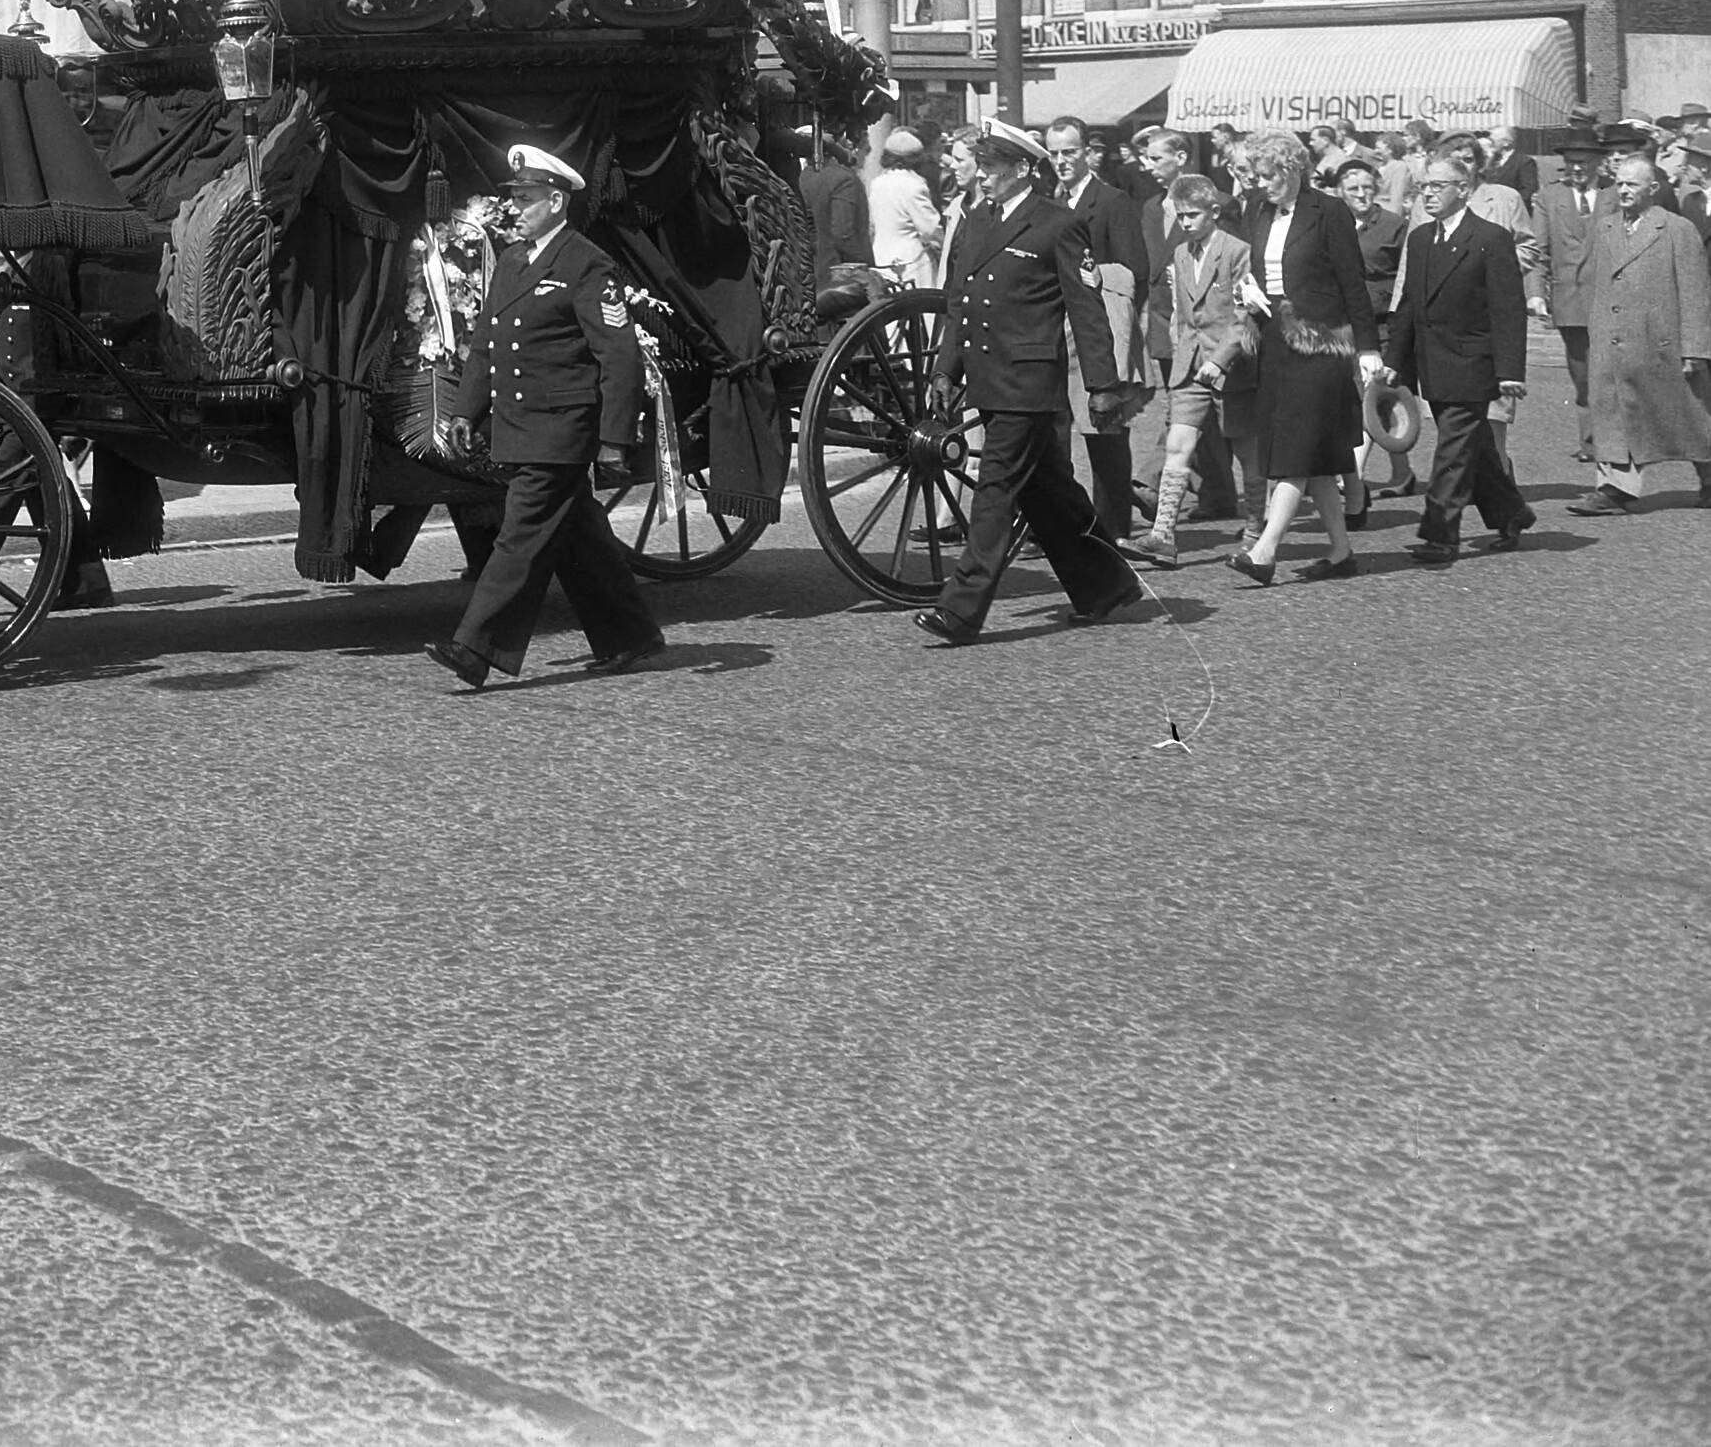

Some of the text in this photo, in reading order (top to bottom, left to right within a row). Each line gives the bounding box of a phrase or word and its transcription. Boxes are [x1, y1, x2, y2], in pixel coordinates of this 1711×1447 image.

[1050, 20, 1104, 46] KLEIN
[1135, 20, 1209, 42] EXPORT
[1261, 94, 1413, 121] VISHANDEL
